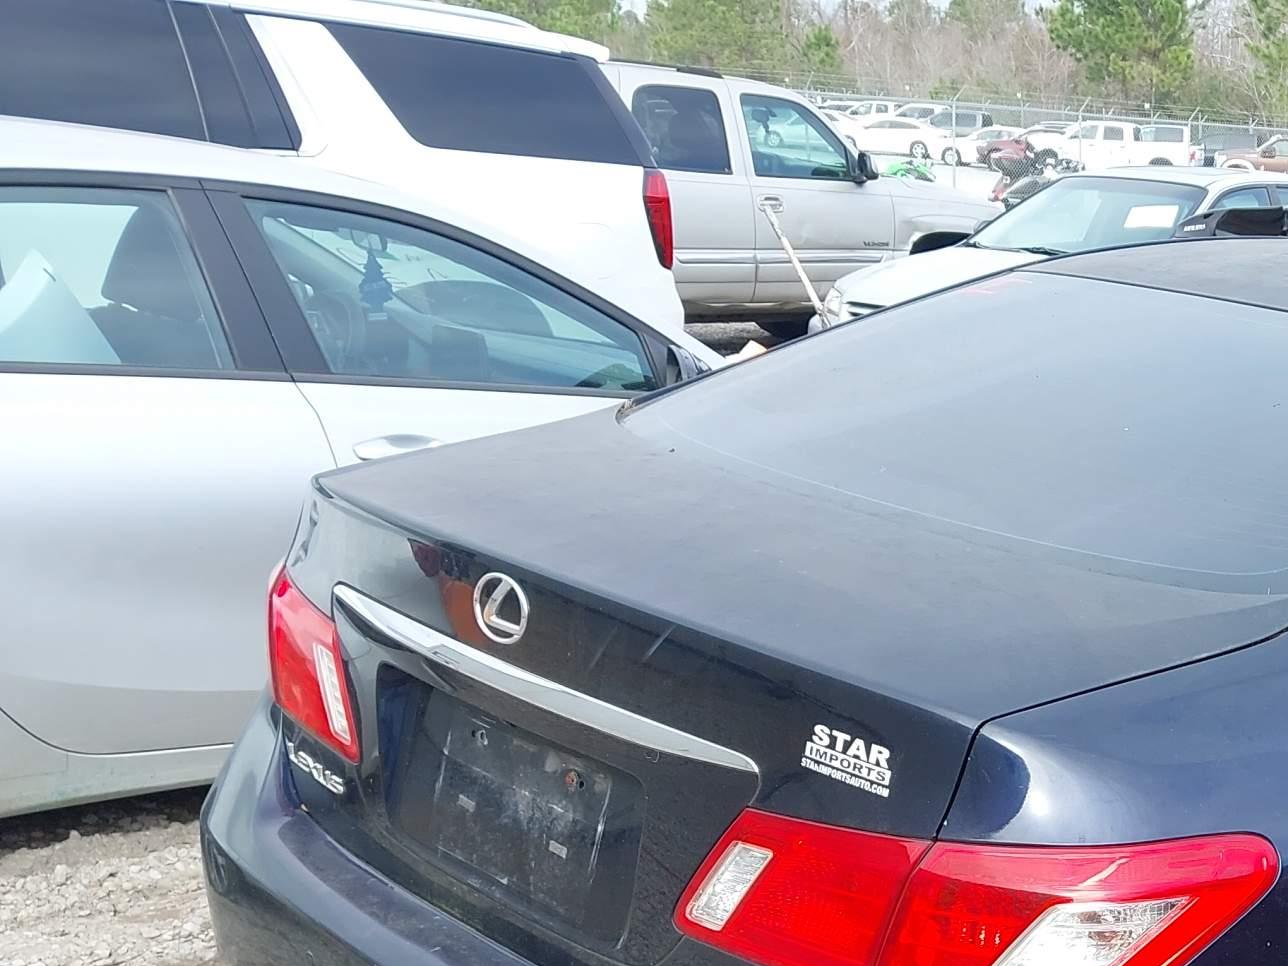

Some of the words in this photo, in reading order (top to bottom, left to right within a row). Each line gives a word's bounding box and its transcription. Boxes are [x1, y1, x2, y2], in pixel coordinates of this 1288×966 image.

[287, 742, 345, 795] LEXUS
[808, 743, 888, 783] IMPORTS
[811, 723, 891, 769] STAR
